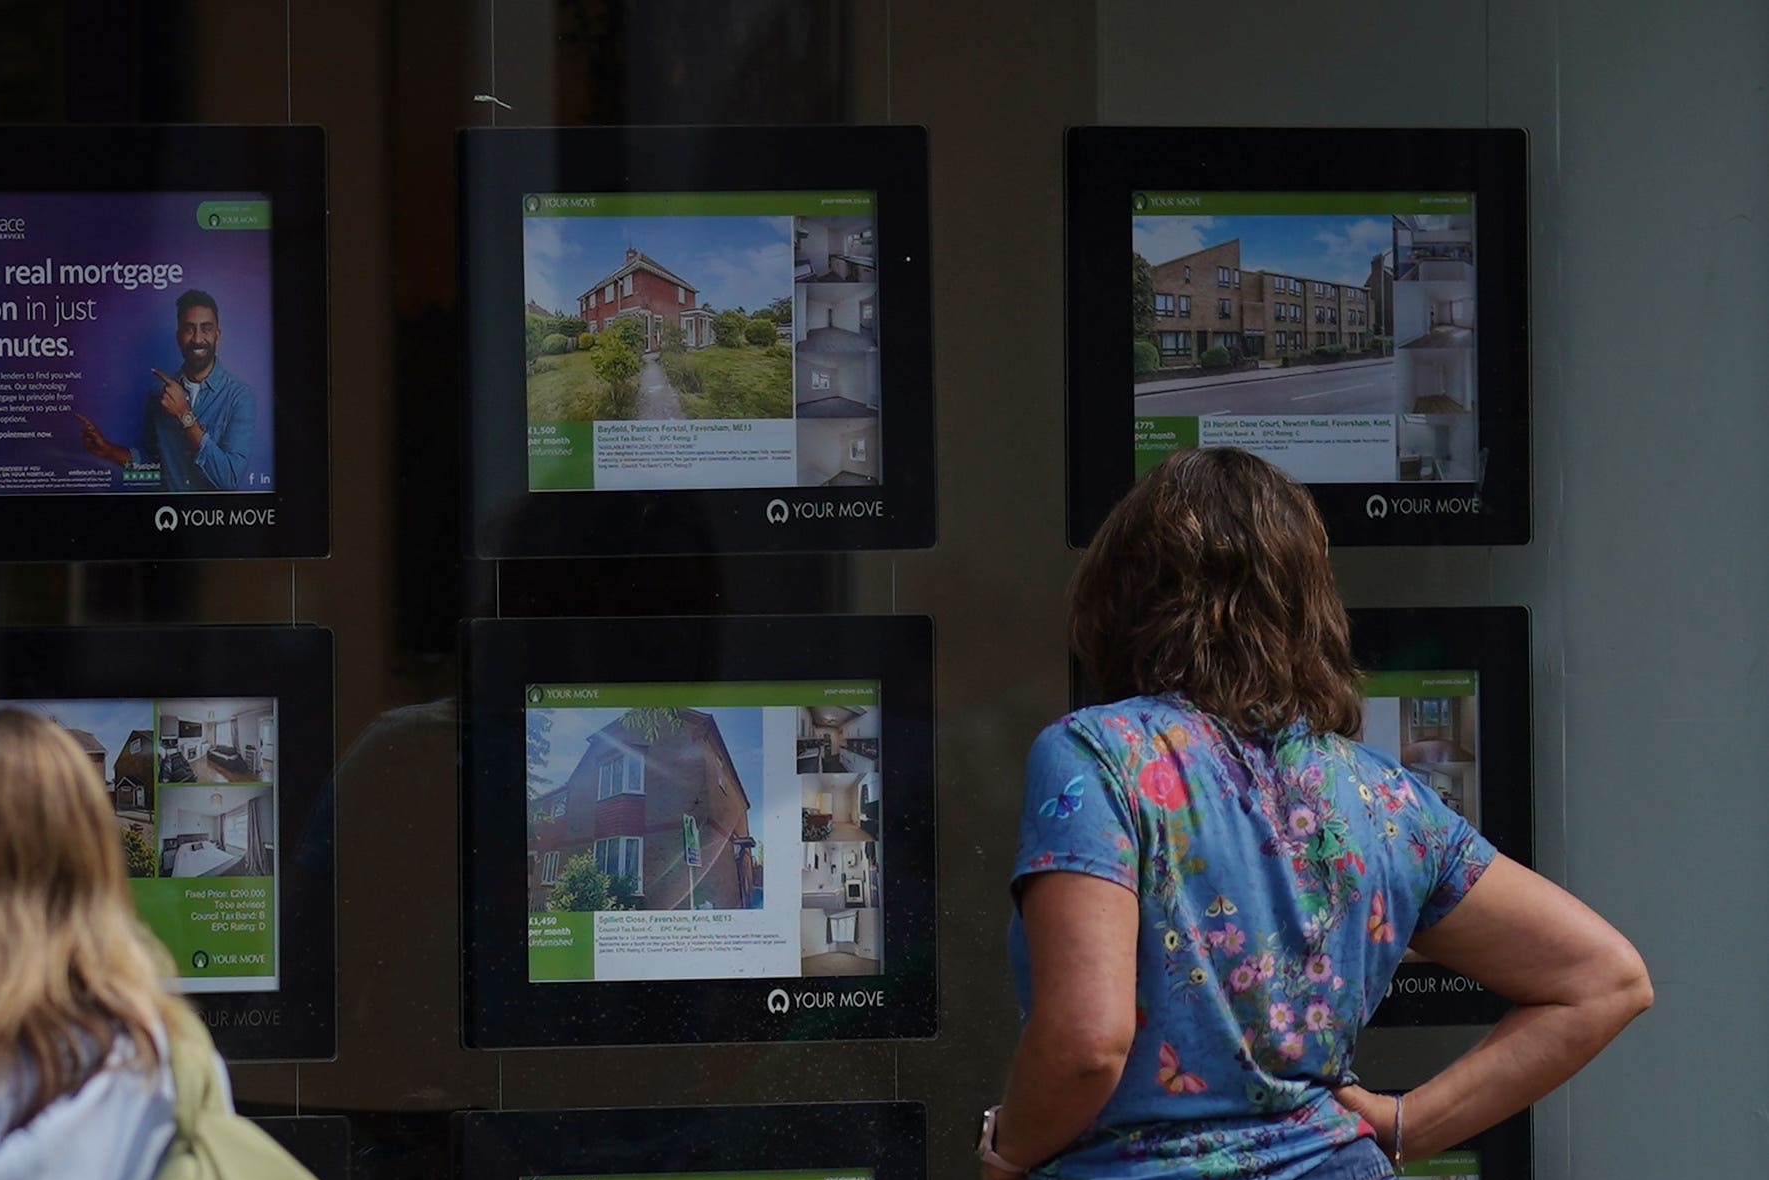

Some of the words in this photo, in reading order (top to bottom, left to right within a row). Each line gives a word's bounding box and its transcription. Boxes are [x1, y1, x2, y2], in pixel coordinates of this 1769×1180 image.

[5, 258, 51, 285] real
[59, 262, 182, 289] mortgage
[26, 295, 45, 320] in
[53, 295, 97, 327] just
[0, 372, 24, 380] lenders
[50, 373, 63, 381] you
[28, 383, 67, 392] technology
[26, 393, 55, 402] principle
[44, 405, 57, 413] you
[631, 424, 658, 434] Painters
[1149, 431, 1176, 439] month
[544, 437, 570, 445] month
[260, 473, 270, 484] in
[792, 501, 835, 518] YOUR
[838, 501, 884, 518] MOVE
[1390, 498, 1432, 514] YOUR
[1435, 498, 1479, 514] MOVE
[181, 509, 224, 526] YOUR
[229, 509, 276, 526] MOVE
[547, 689, 571, 699] YOUR
[573, 689, 600, 699] MOVE
[190, 912, 219, 921] Council
[221, 912, 234, 921] Tax
[211, 923, 229, 932] EPC
[544, 927, 571, 936] month
[211, 954, 237, 964] YOUR
[239, 954, 266, 964] MOVE
[1395, 977, 1437, 993] YOUR
[793, 991, 835, 1009] YOUR
[839, 991, 884, 1009] MOVE
[197, 1009, 231, 1027] OUR
[234, 1009, 280, 1026] MOVE
